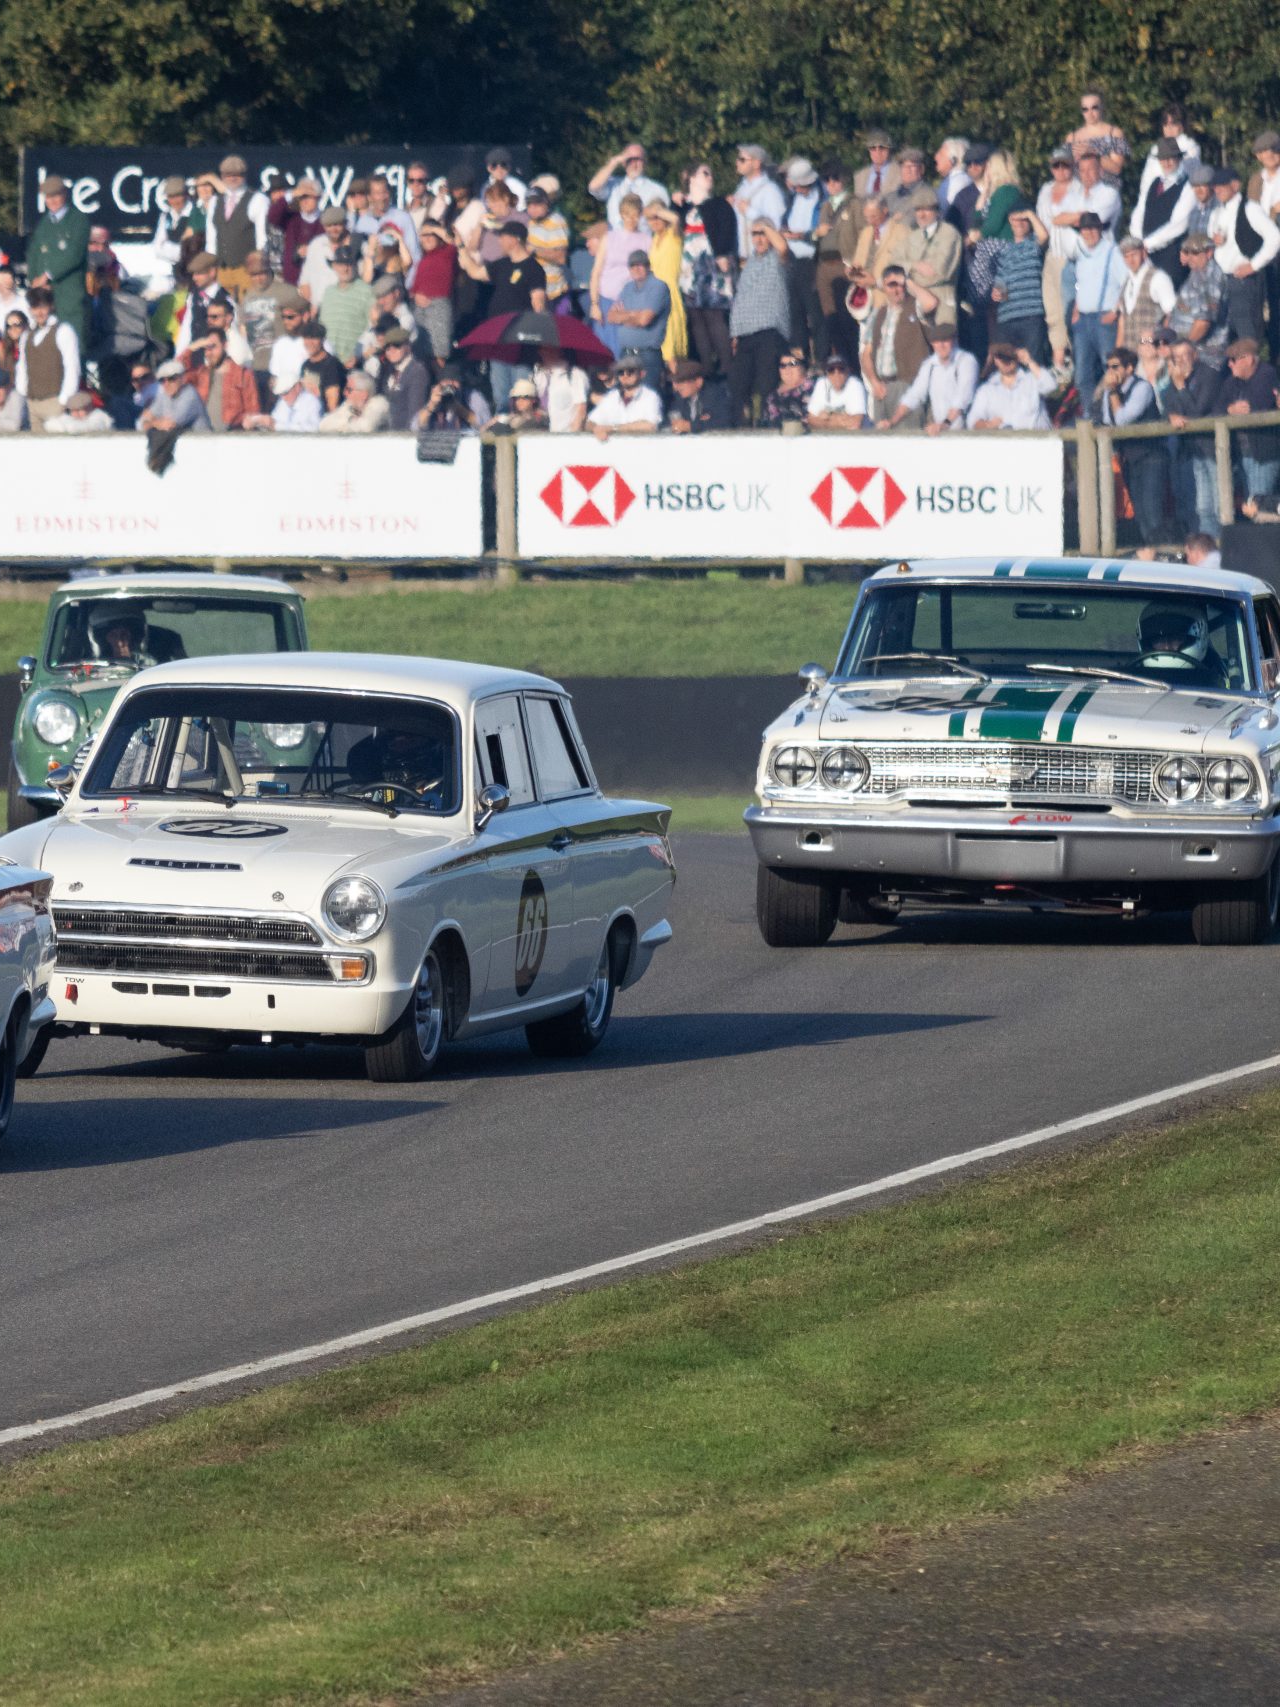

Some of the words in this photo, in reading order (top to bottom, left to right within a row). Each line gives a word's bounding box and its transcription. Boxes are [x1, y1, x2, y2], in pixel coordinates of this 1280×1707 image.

[37, 165, 101, 213] Ie
[644, 483, 726, 512] HSBC
[732, 483, 773, 512] UK
[916, 485, 997, 514] HSBC
[1005, 486, 1045, 515] UK
[15, 515, 159, 534] EDMISTON
[279, 514, 420, 534] EDMISTON
[1035, 814, 1073, 823] TOW
[140, 859, 229, 870] CORTINA
[517, 898, 545, 970] 66
[63, 976, 85, 984] TOW
